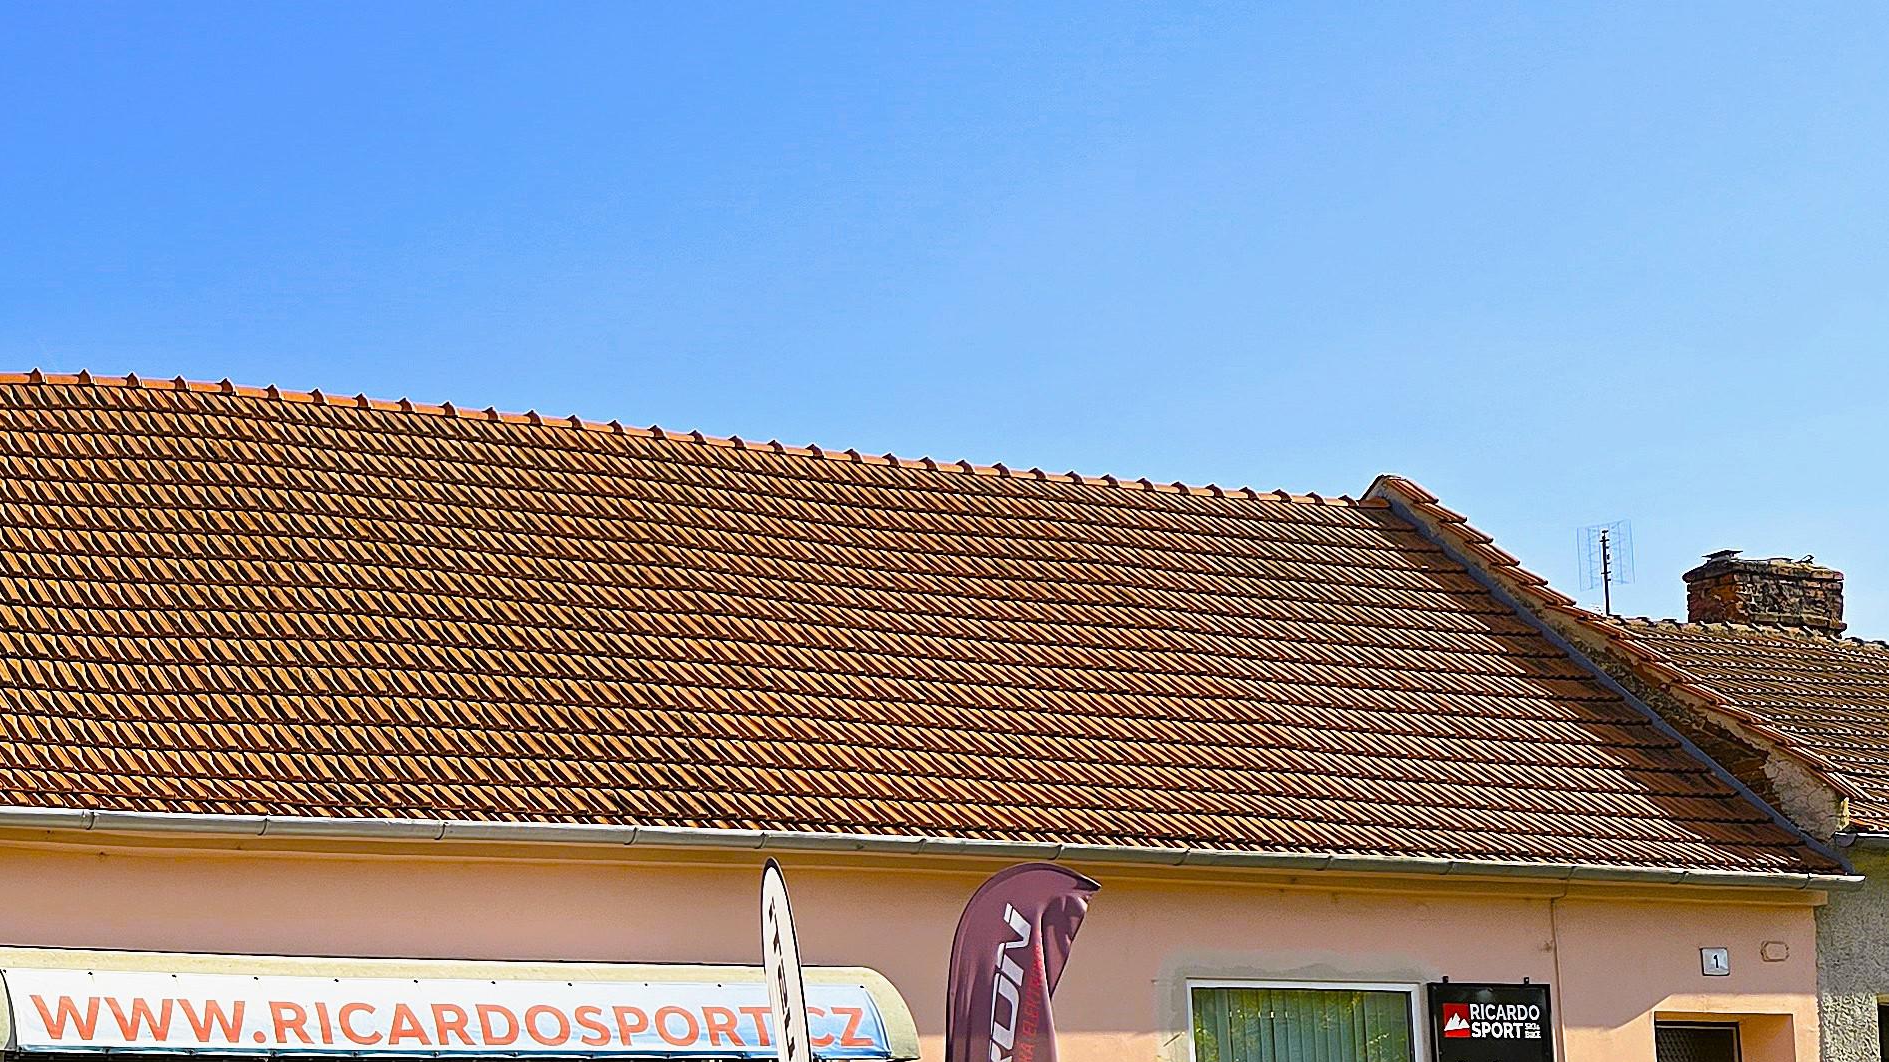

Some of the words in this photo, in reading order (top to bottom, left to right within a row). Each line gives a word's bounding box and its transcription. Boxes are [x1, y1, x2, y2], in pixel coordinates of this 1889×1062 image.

[1713, 954, 1720, 969] 1
[30, 994, 874, 1048] WWW.RICARDOSPORTCZ
[1469, 1003, 1540, 1021] RICARDO
[1471, 1021, 1523, 1039] SPORT
